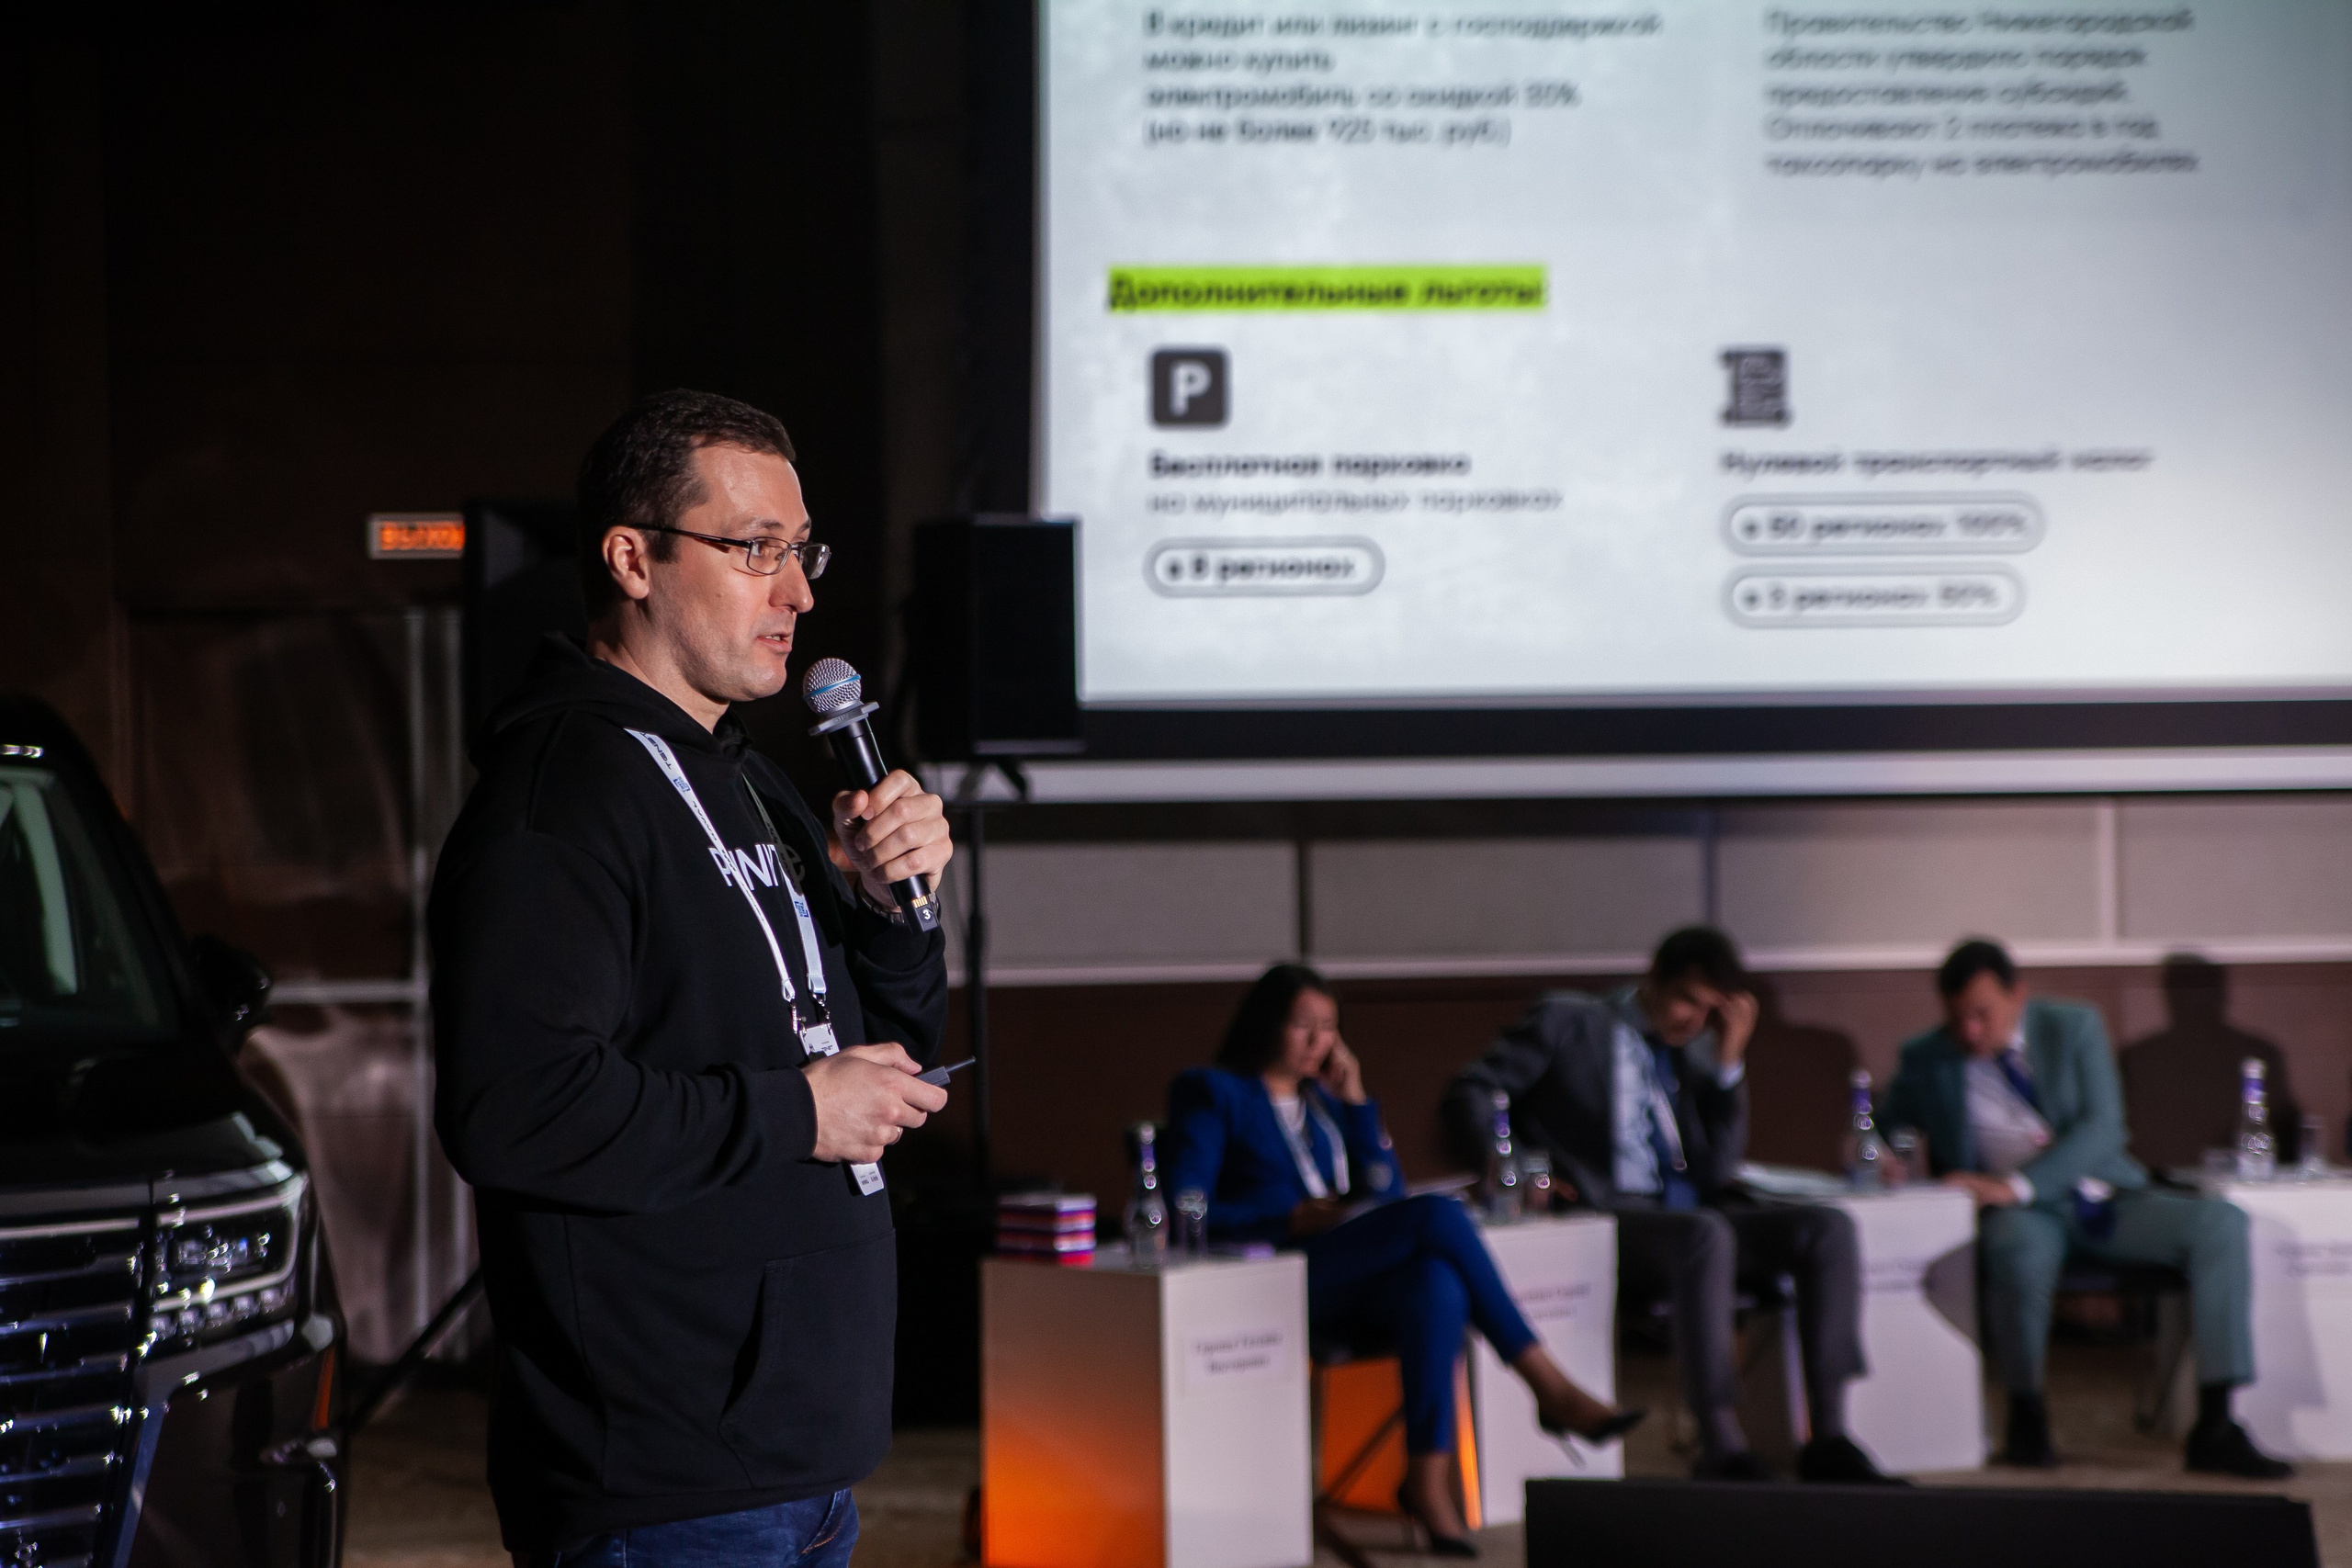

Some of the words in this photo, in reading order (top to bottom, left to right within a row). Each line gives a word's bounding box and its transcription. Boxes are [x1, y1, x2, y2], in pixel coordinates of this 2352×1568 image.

[1107, 274, 1408, 310] Дополнительные
[1148, 449, 1323, 478] Бесплатная
[1332, 453, 1469, 481] парковка
[1216, 558, 1356, 585] регионах
[922, 909, 931, 920] 3
